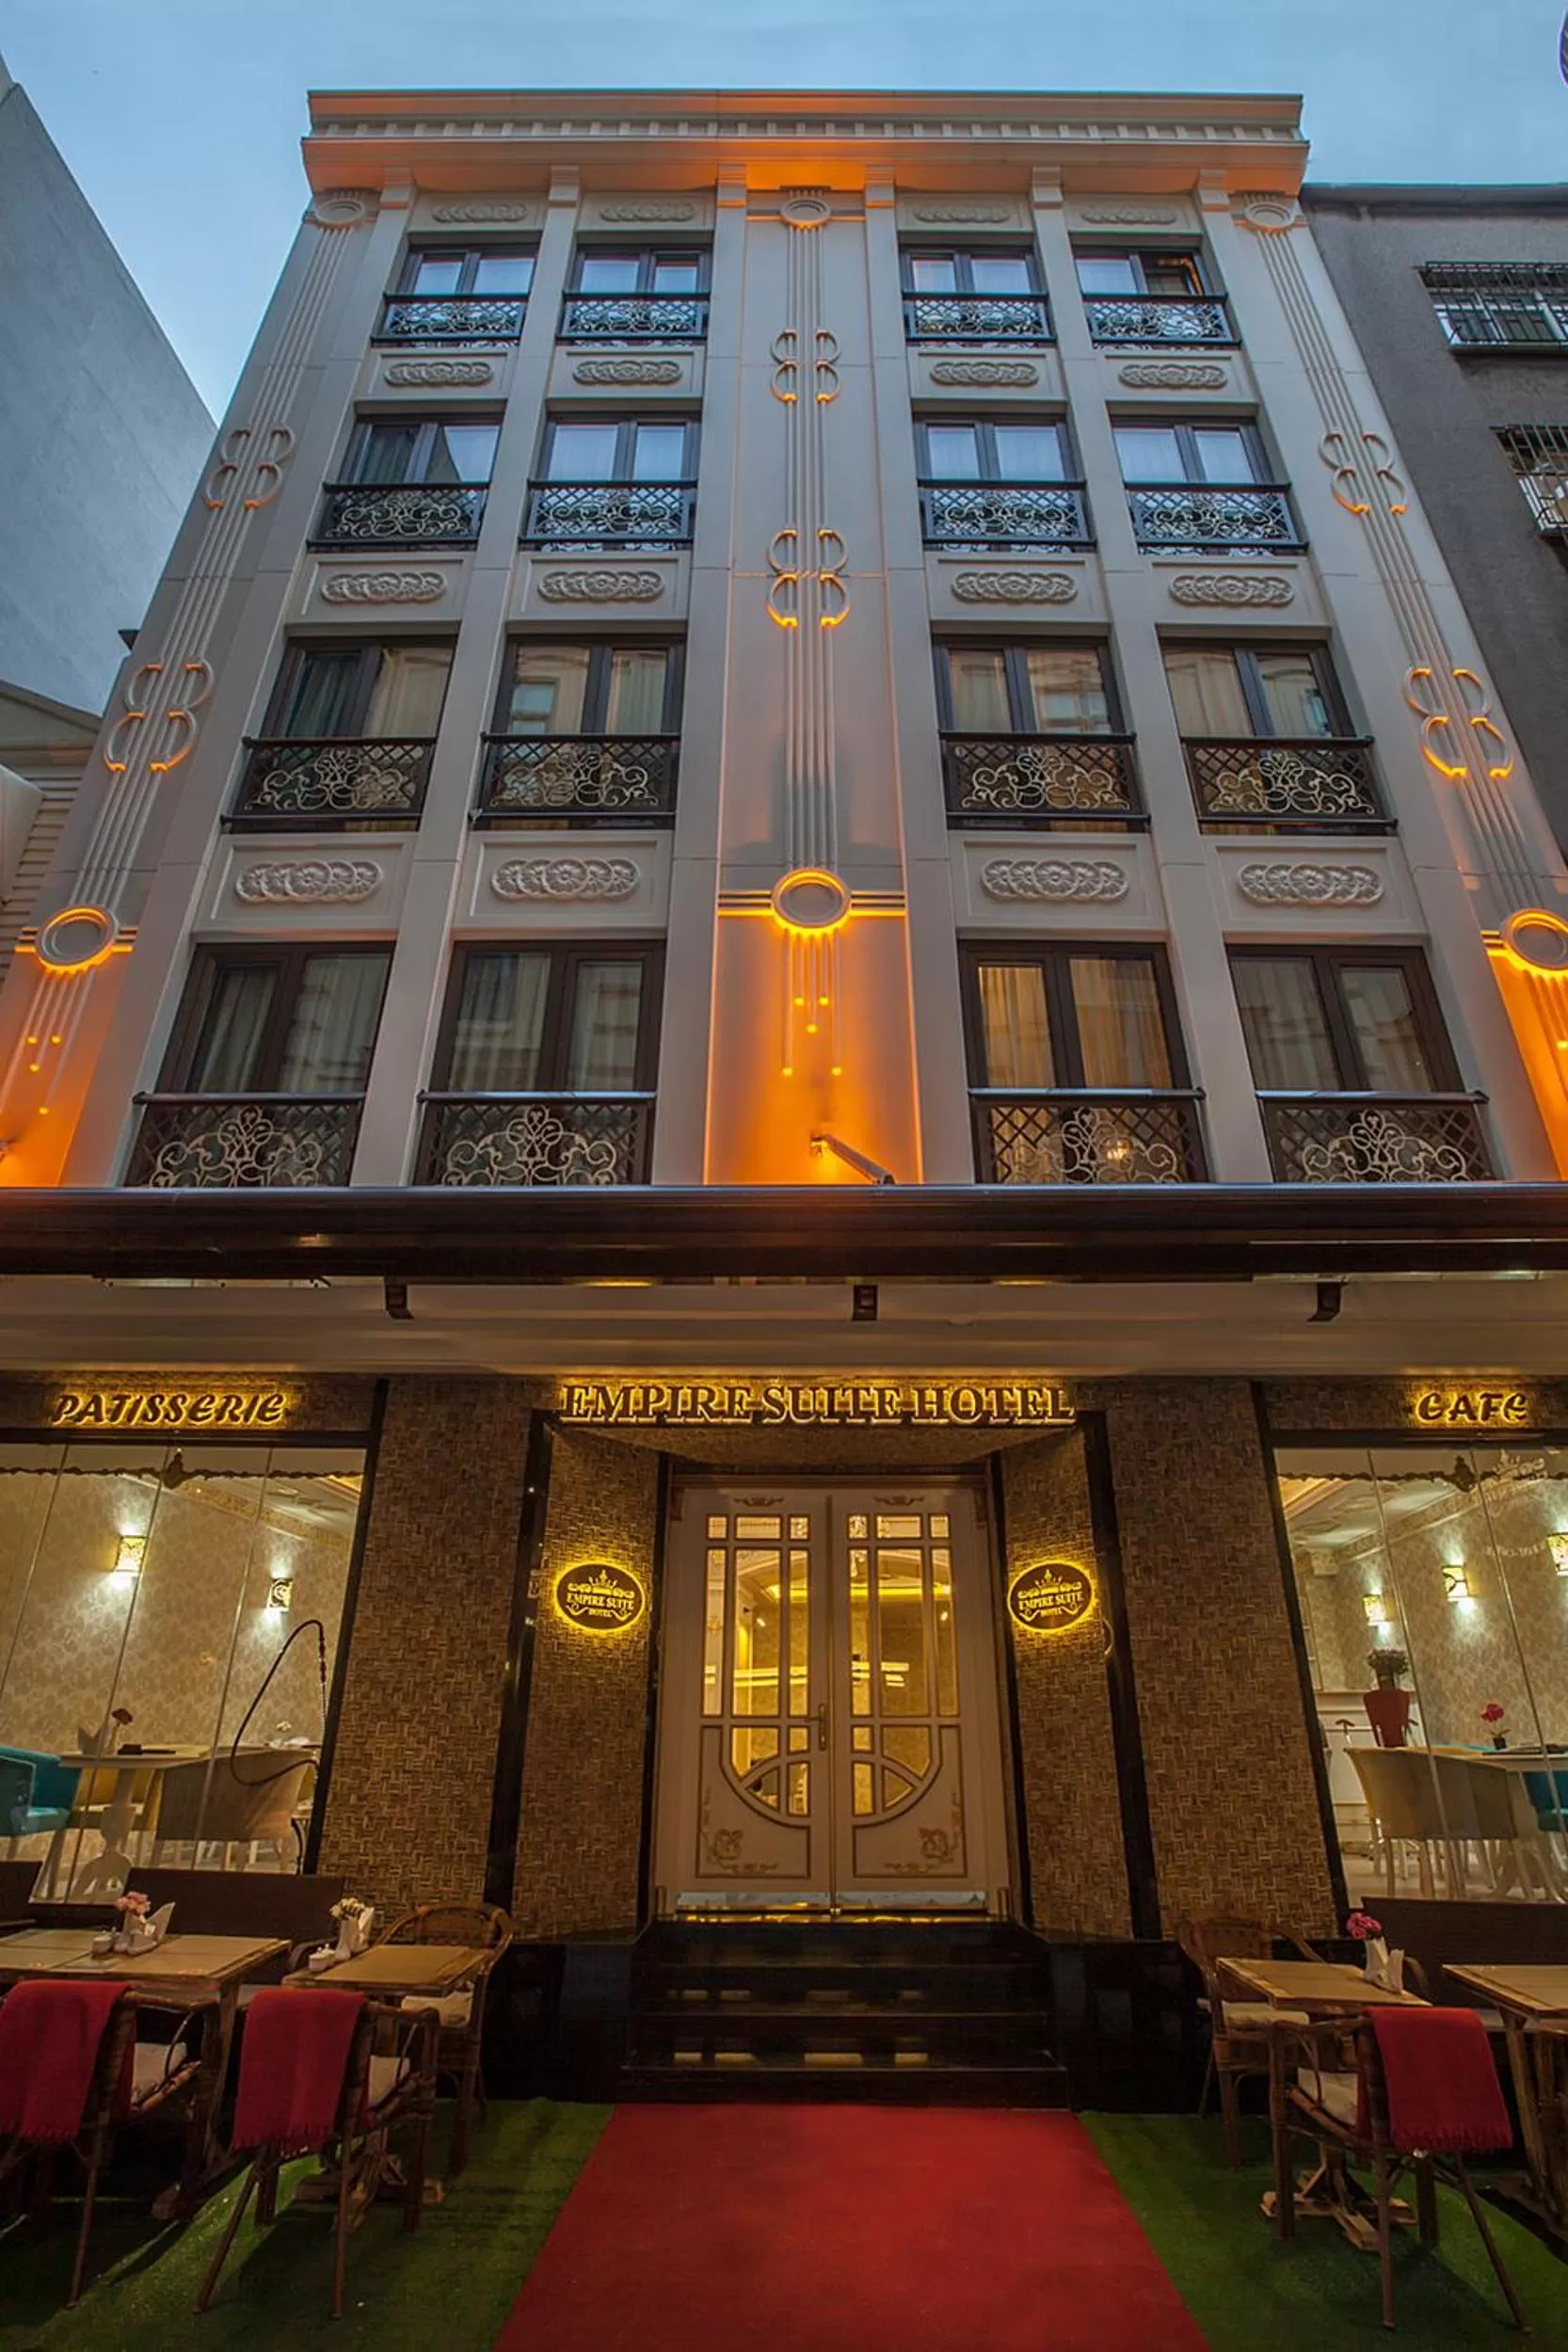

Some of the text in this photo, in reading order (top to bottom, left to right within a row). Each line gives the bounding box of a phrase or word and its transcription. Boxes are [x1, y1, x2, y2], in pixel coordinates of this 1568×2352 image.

[53, 1393, 287, 1425] PATISSERIE
[560, 1384, 1077, 1424] EMPIRE SUITE HOTEL
[1416, 1392, 1528, 1423] CAFE
[567, 1592, 634, 1610] EMPIRE SUITE
[1018, 1591, 1084, 1610] EMPIRE SUITE
